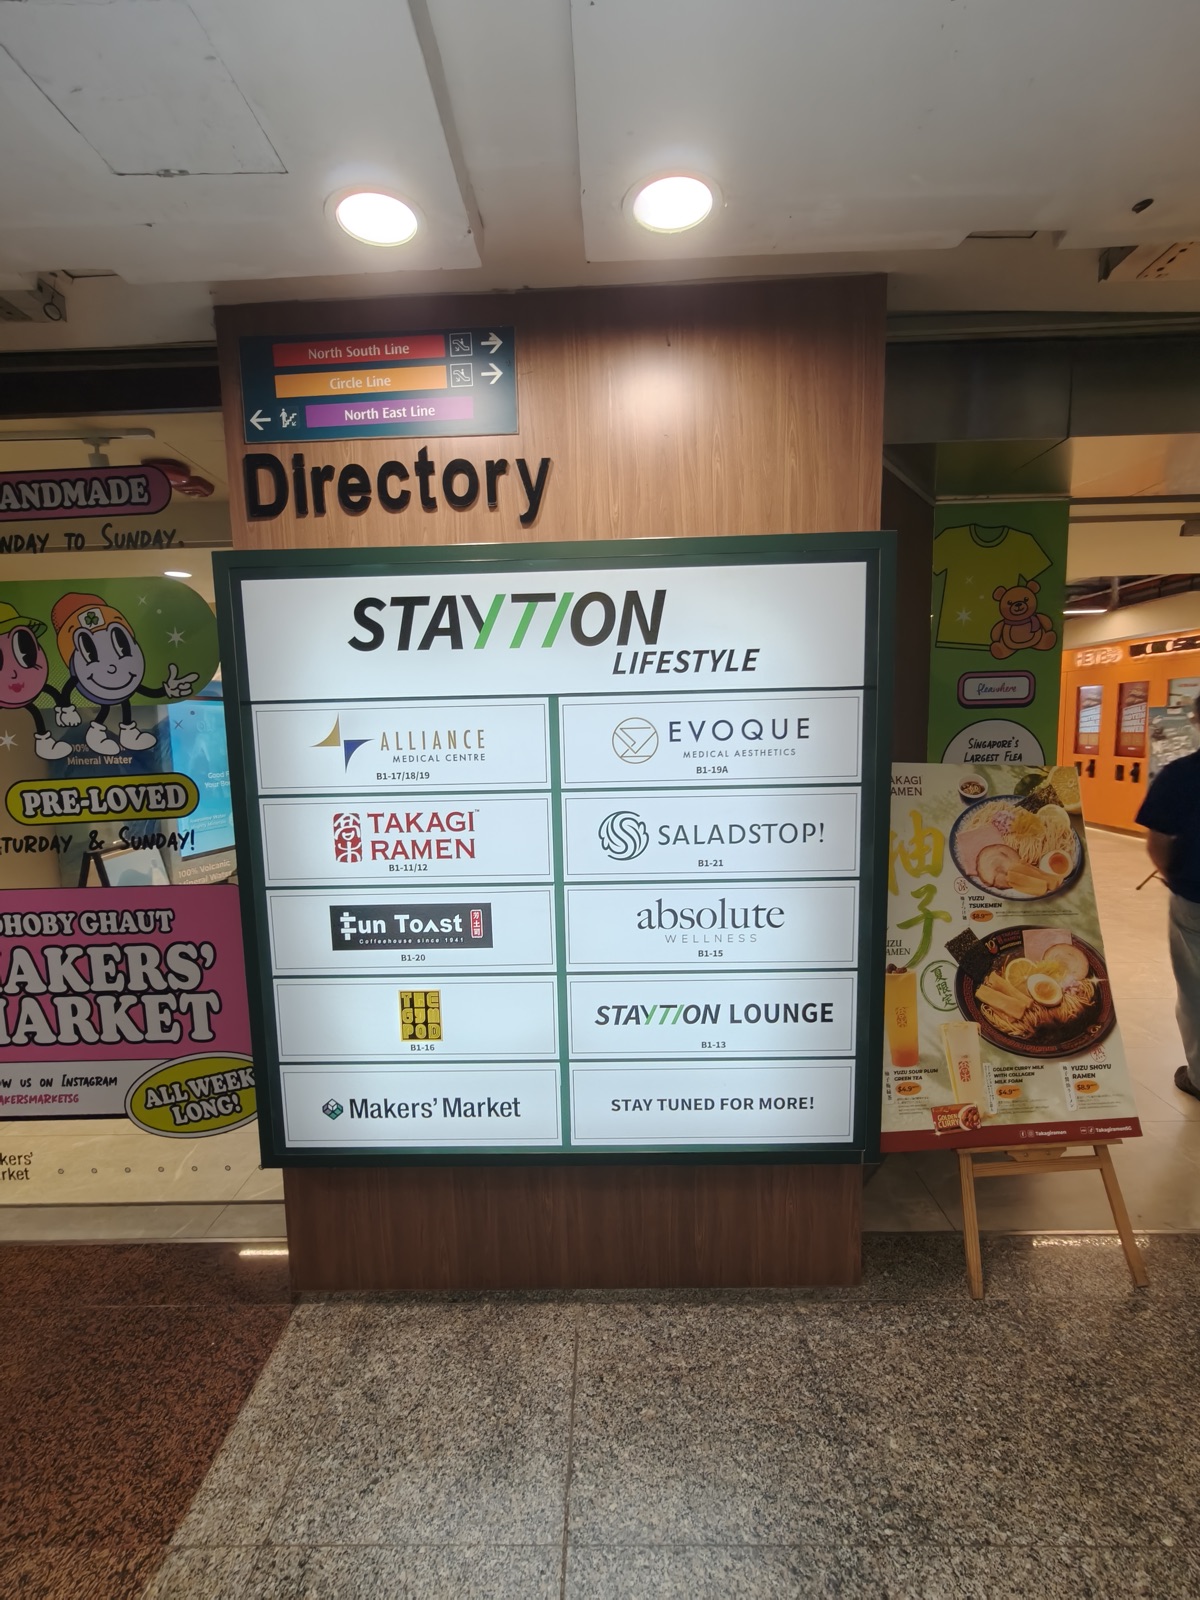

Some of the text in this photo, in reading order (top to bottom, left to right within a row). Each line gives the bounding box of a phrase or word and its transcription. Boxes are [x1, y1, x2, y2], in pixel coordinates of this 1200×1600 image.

[307, 343, 410, 360] North South Line
[329, 375, 391, 390] Circle Line
[344, 405, 435, 421] North East Line
[244, 446, 551, 525] Directory
[64, 533, 85, 550] TO
[101, 522, 185, 550] SUNDAY.
[347, 589, 667, 652] STAYTION
[611, 648, 761, 676] LIFESTYLE
[976, 682, 1017, 696] fleawhere
[668, 717, 810, 743] EVOQUE
[380, 729, 486, 752] ALLIANCE
[67, 754, 133, 766] Mineral Water
[392, 753, 487, 764] MEDICAL CENTRE
[682, 748, 797, 759] MEDICAL AESTHETICS
[963, 750, 1023, 763] LARGEST FLEA
[376, 771, 430, 781] B1-17/18/19
[696, 765, 729, 775] B1-19A
[20, 783, 188, 818] PRE-LOVED
[366, 811, 476, 834] TAKAGI
[88, 829, 105, 851] &
[118, 826, 195, 852] SUNDAY!
[657, 822, 825, 847] SALADSTOP!
[370, 838, 476, 860] RAMEN
[178, 859, 232, 879] 100% Volcanic
[388, 863, 428, 873] B1-11/12
[698, 859, 724, 868] B1-21
[78, 909, 175, 934] GHAUT
[636, 897, 785, 931] absolute
[340, 911, 463, 940] Fun Toast
[664, 933, 758, 944] WELLNESS
[400, 953, 426, 962] B1-20
[697, 949, 724, 958] B1-15
[0, 942, 216, 994] AKERS'
[401, 992, 440, 1008] THE
[402, 1008, 441, 1024] GYM
[594, 1002, 834, 1026] STAYTION LOUNGE
[402, 1023, 441, 1039] POD
[410, 1043, 436, 1052] B1-16
[701, 1041, 727, 1050] B1-13
[1070, 1063, 1112, 1072] YUZU SHOYU
[20, 1077, 32, 1088] US
[39, 1077, 54, 1088] ON
[61, 1073, 118, 1088] INSTAGRAM
[1072, 1072, 1096, 1080] RAMEN
[146, 1067, 256, 1108] ALL WEEK
[171, 1093, 242, 1125] LONG!
[348, 1096, 521, 1119] Makers' Market
[611, 1095, 815, 1112] STAY TUNED FOR MORE!
[938, 1120, 960, 1128] CURRY
[0, 1167, 30, 1181] rket
